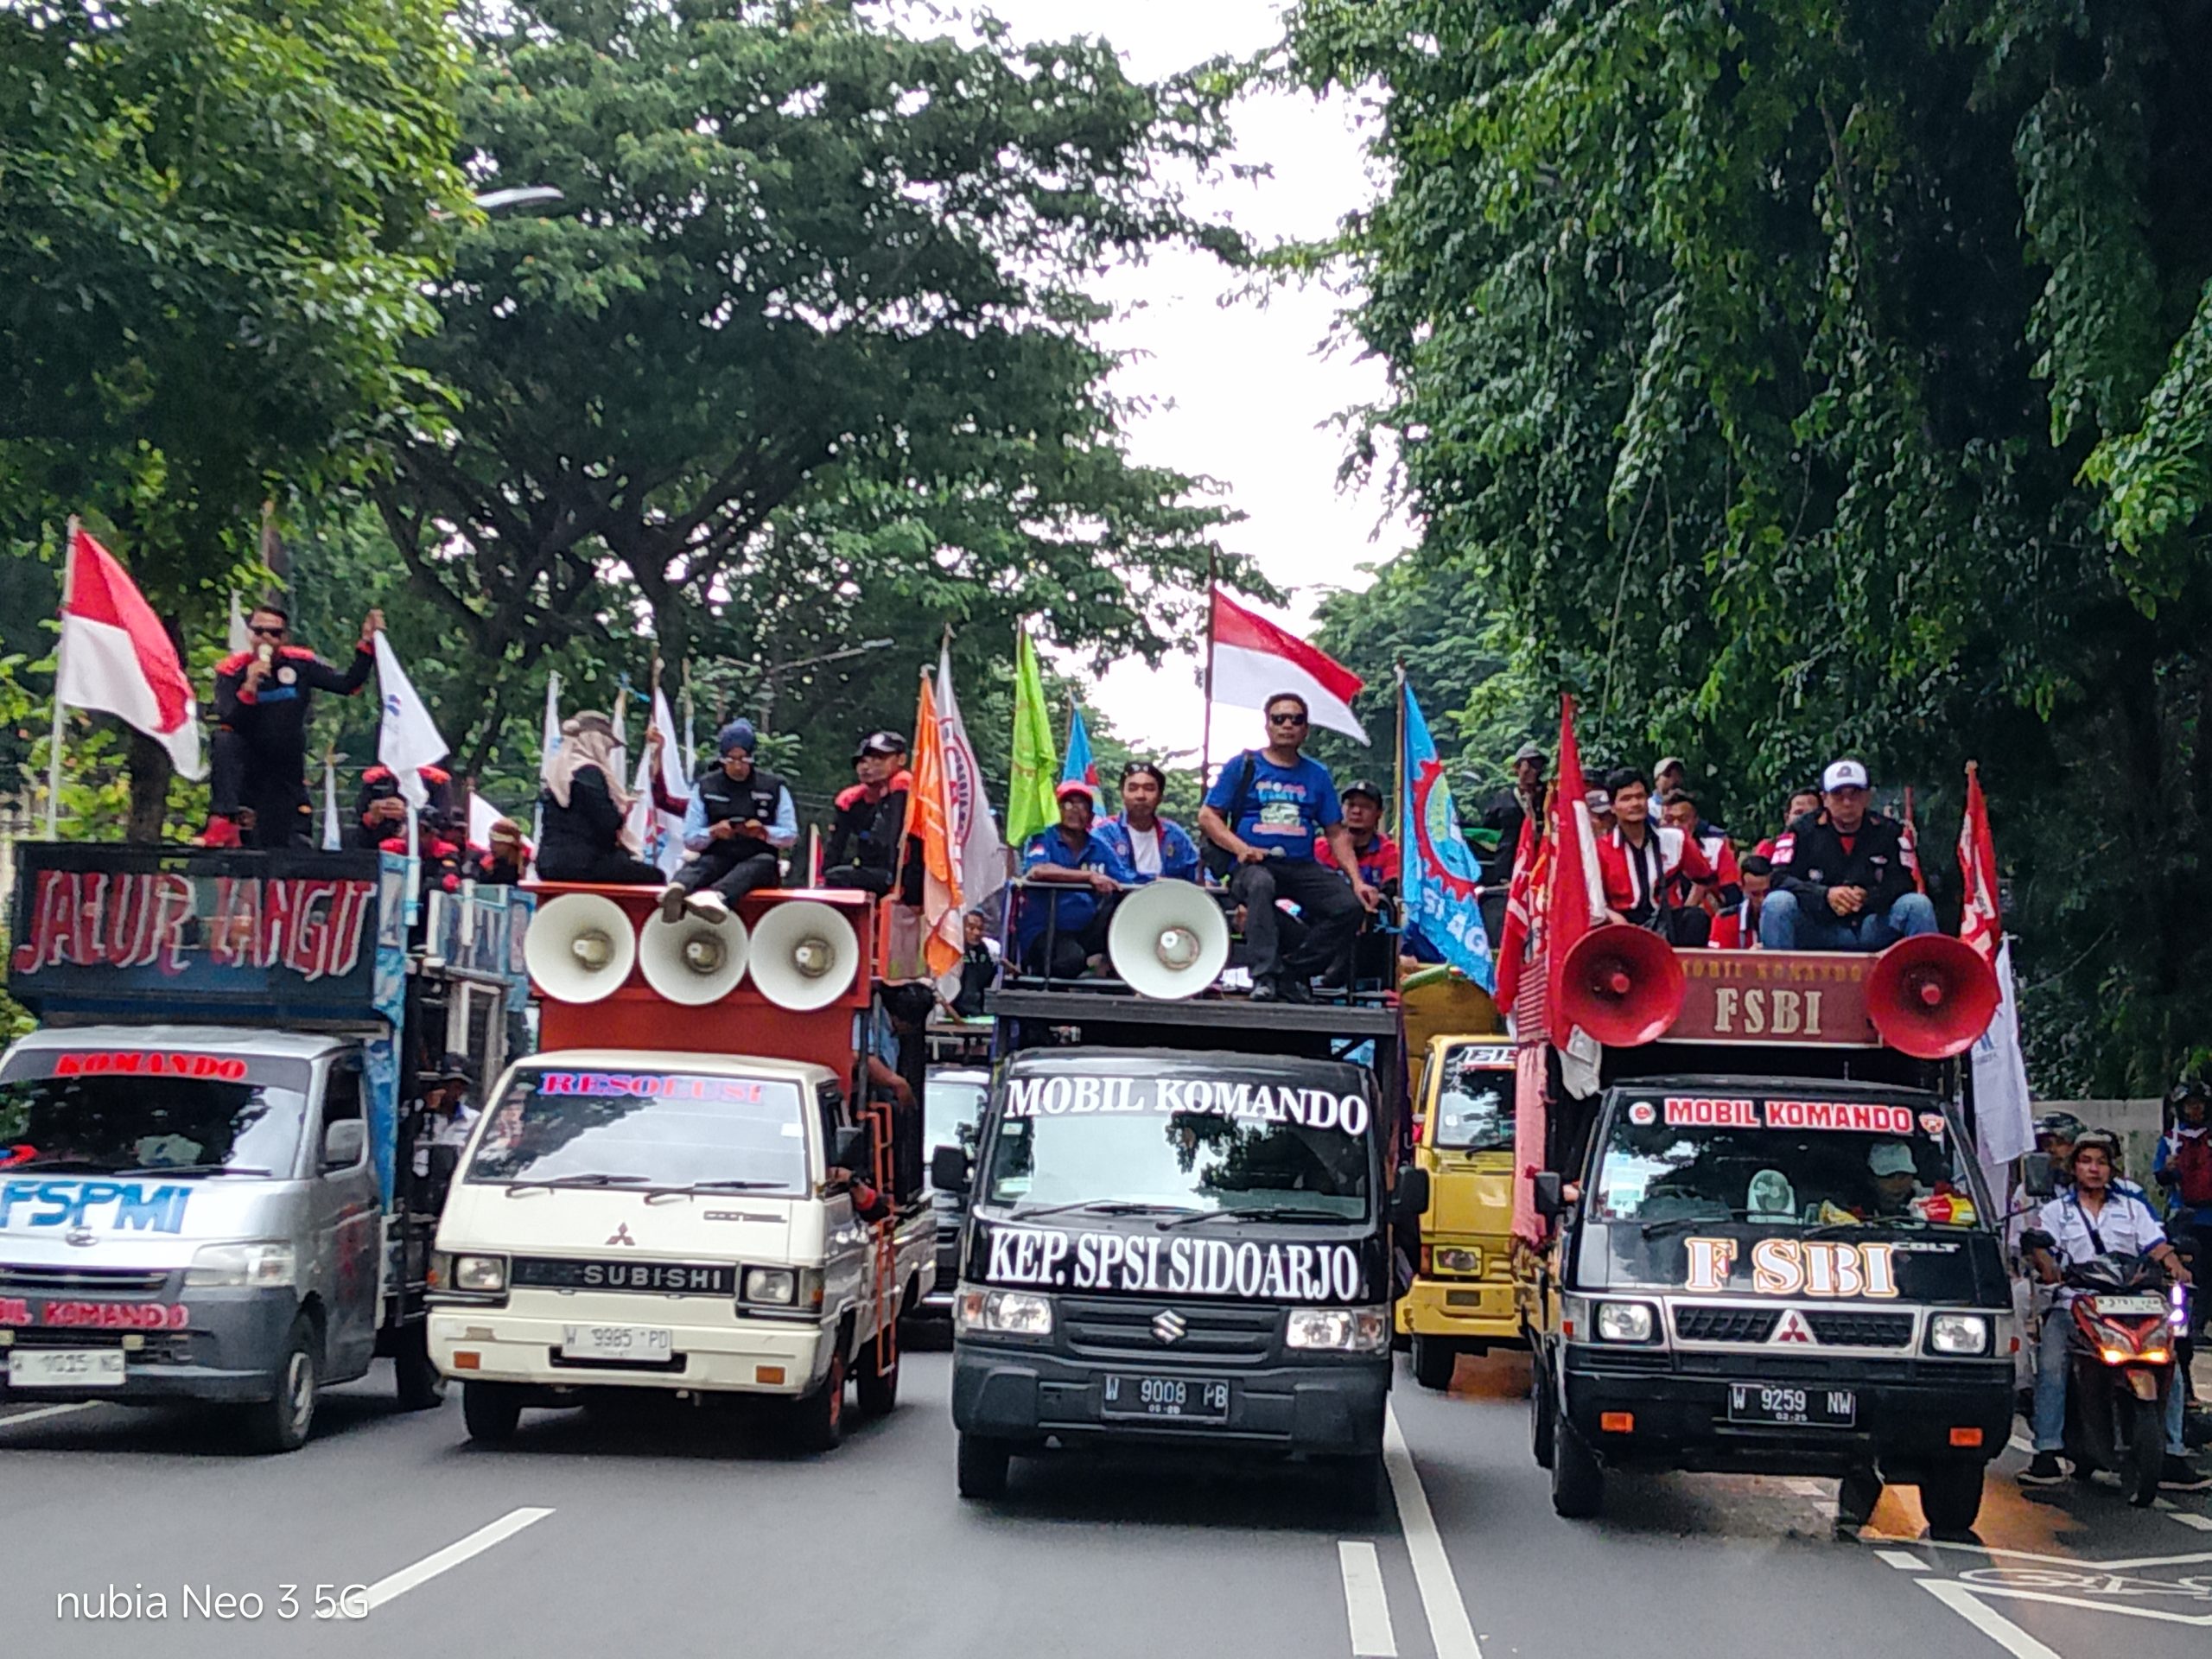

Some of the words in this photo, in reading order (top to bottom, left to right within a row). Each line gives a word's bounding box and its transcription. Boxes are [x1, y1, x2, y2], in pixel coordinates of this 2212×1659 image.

[14, 869, 195, 975] JALUR
[1714, 988, 1822, 1034] FSBI
[54, 1052, 248, 1080] KOMANDO
[1004, 1077, 1145, 1118] MOBIL
[1155, 1079, 1369, 1135] KOMANDO
[1667, 1099, 1759, 1127] MOBIL
[1765, 1102, 1912, 1134] KOMANDO
[0, 1180, 193, 1234] FSPMI
[986, 1228, 1065, 1286] KEP.
[1074, 1233, 1161, 1291] SPSI
[1169, 1237, 1359, 1301] SIDOARJO
[43, 1301, 189, 1331] KOMANDO
[1105, 1377, 1119, 1400] W
[1141, 1380, 1186, 1404] 9008
[1732, 1388, 1745, 1409] W
[1761, 1389, 1806, 1411] 9259
[1827, 1392, 1852, 1414] NW
